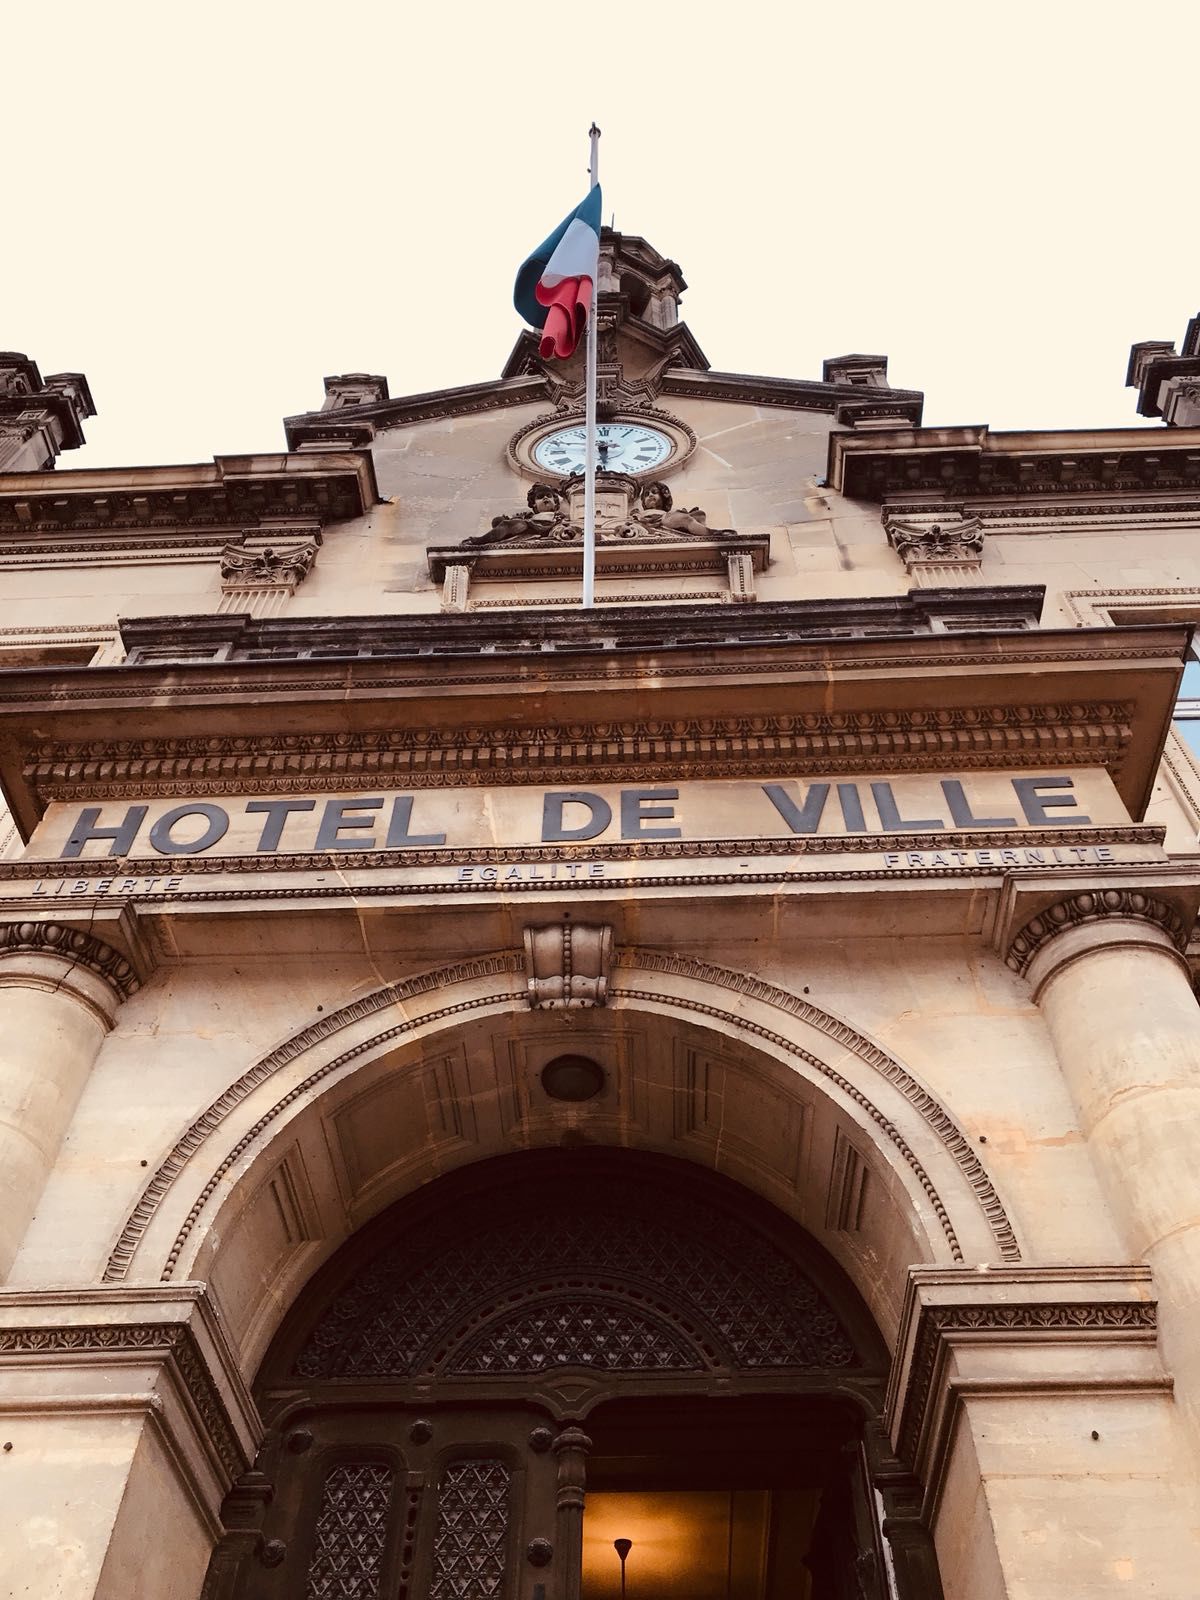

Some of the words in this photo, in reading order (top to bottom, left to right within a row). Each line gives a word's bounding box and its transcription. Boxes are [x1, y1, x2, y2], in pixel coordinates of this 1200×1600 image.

[60, 796, 446, 858] HOTEL
[541, 789, 682, 842] DE
[761, 776, 1092, 833] VILLE
[32, 877, 183, 895] LIBERTE
[457, 864, 605, 882] EGALITE
[884, 848, 1115, 868] FRATERNITE
